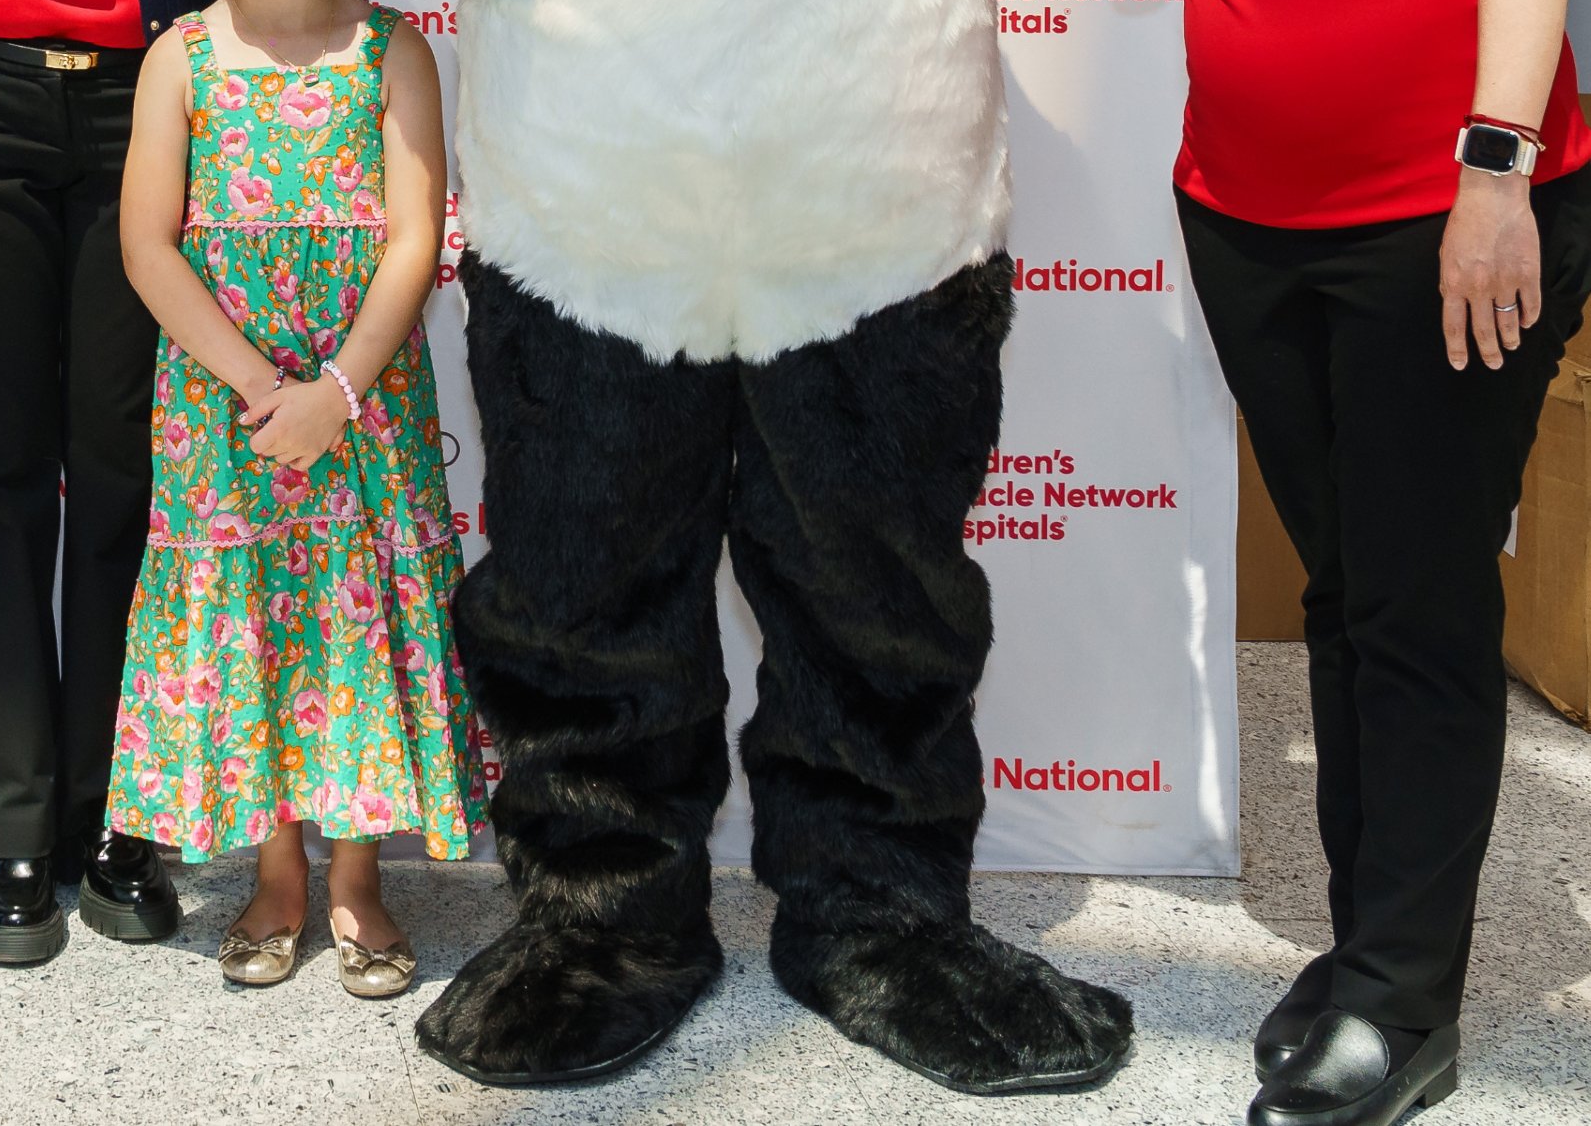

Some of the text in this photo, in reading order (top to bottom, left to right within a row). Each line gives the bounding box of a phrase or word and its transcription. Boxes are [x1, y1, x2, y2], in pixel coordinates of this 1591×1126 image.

[1000, 6, 1069, 35] itals
[987, 449, 1075, 475] dren's
[1043, 481, 1177, 509] Network
[963, 513, 1065, 546] spitals
[993, 756, 1161, 793] National
